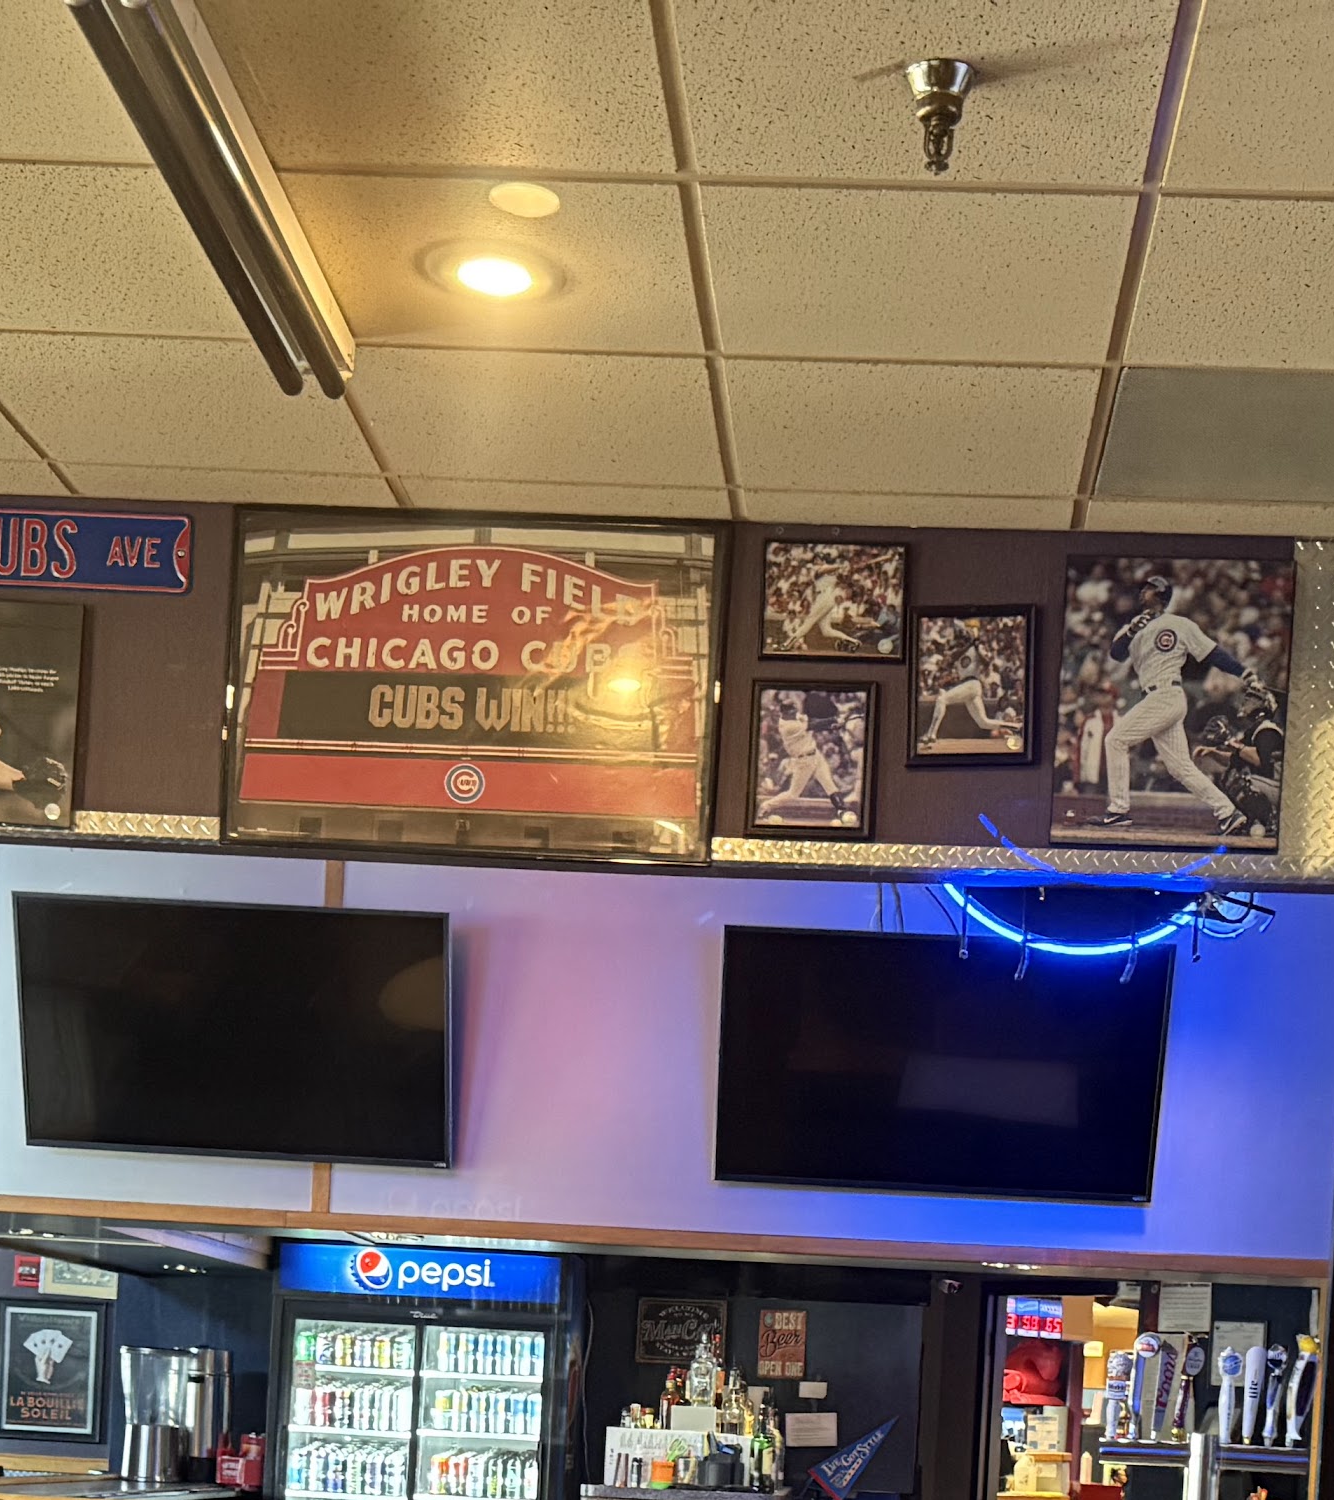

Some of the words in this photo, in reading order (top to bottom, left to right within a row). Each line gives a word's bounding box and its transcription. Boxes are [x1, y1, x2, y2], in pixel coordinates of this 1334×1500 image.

[106, 536, 162, 568] AVE
[315, 558, 502, 622] WRIGLEY
[521, 561, 643, 626] FIELD
[401, 603, 489, 624] HOME
[511, 605, 552, 625] OF
[306, 636, 499, 671] CHICAGO
[368, 684, 465, 731] CUBS
[398, 1258, 491, 1291] pepsi
[659, 1305, 709, 1320] WELCOME
[774, 1312, 803, 1330] BEST
[760, 1330, 802, 1359] Beer
[758, 1361, 782, 1376] OPEN
[785, 1362, 804, 1377] ONE
[9, 1396, 25, 1407] LA
[20, 1407, 72, 1420] SOLEIL
